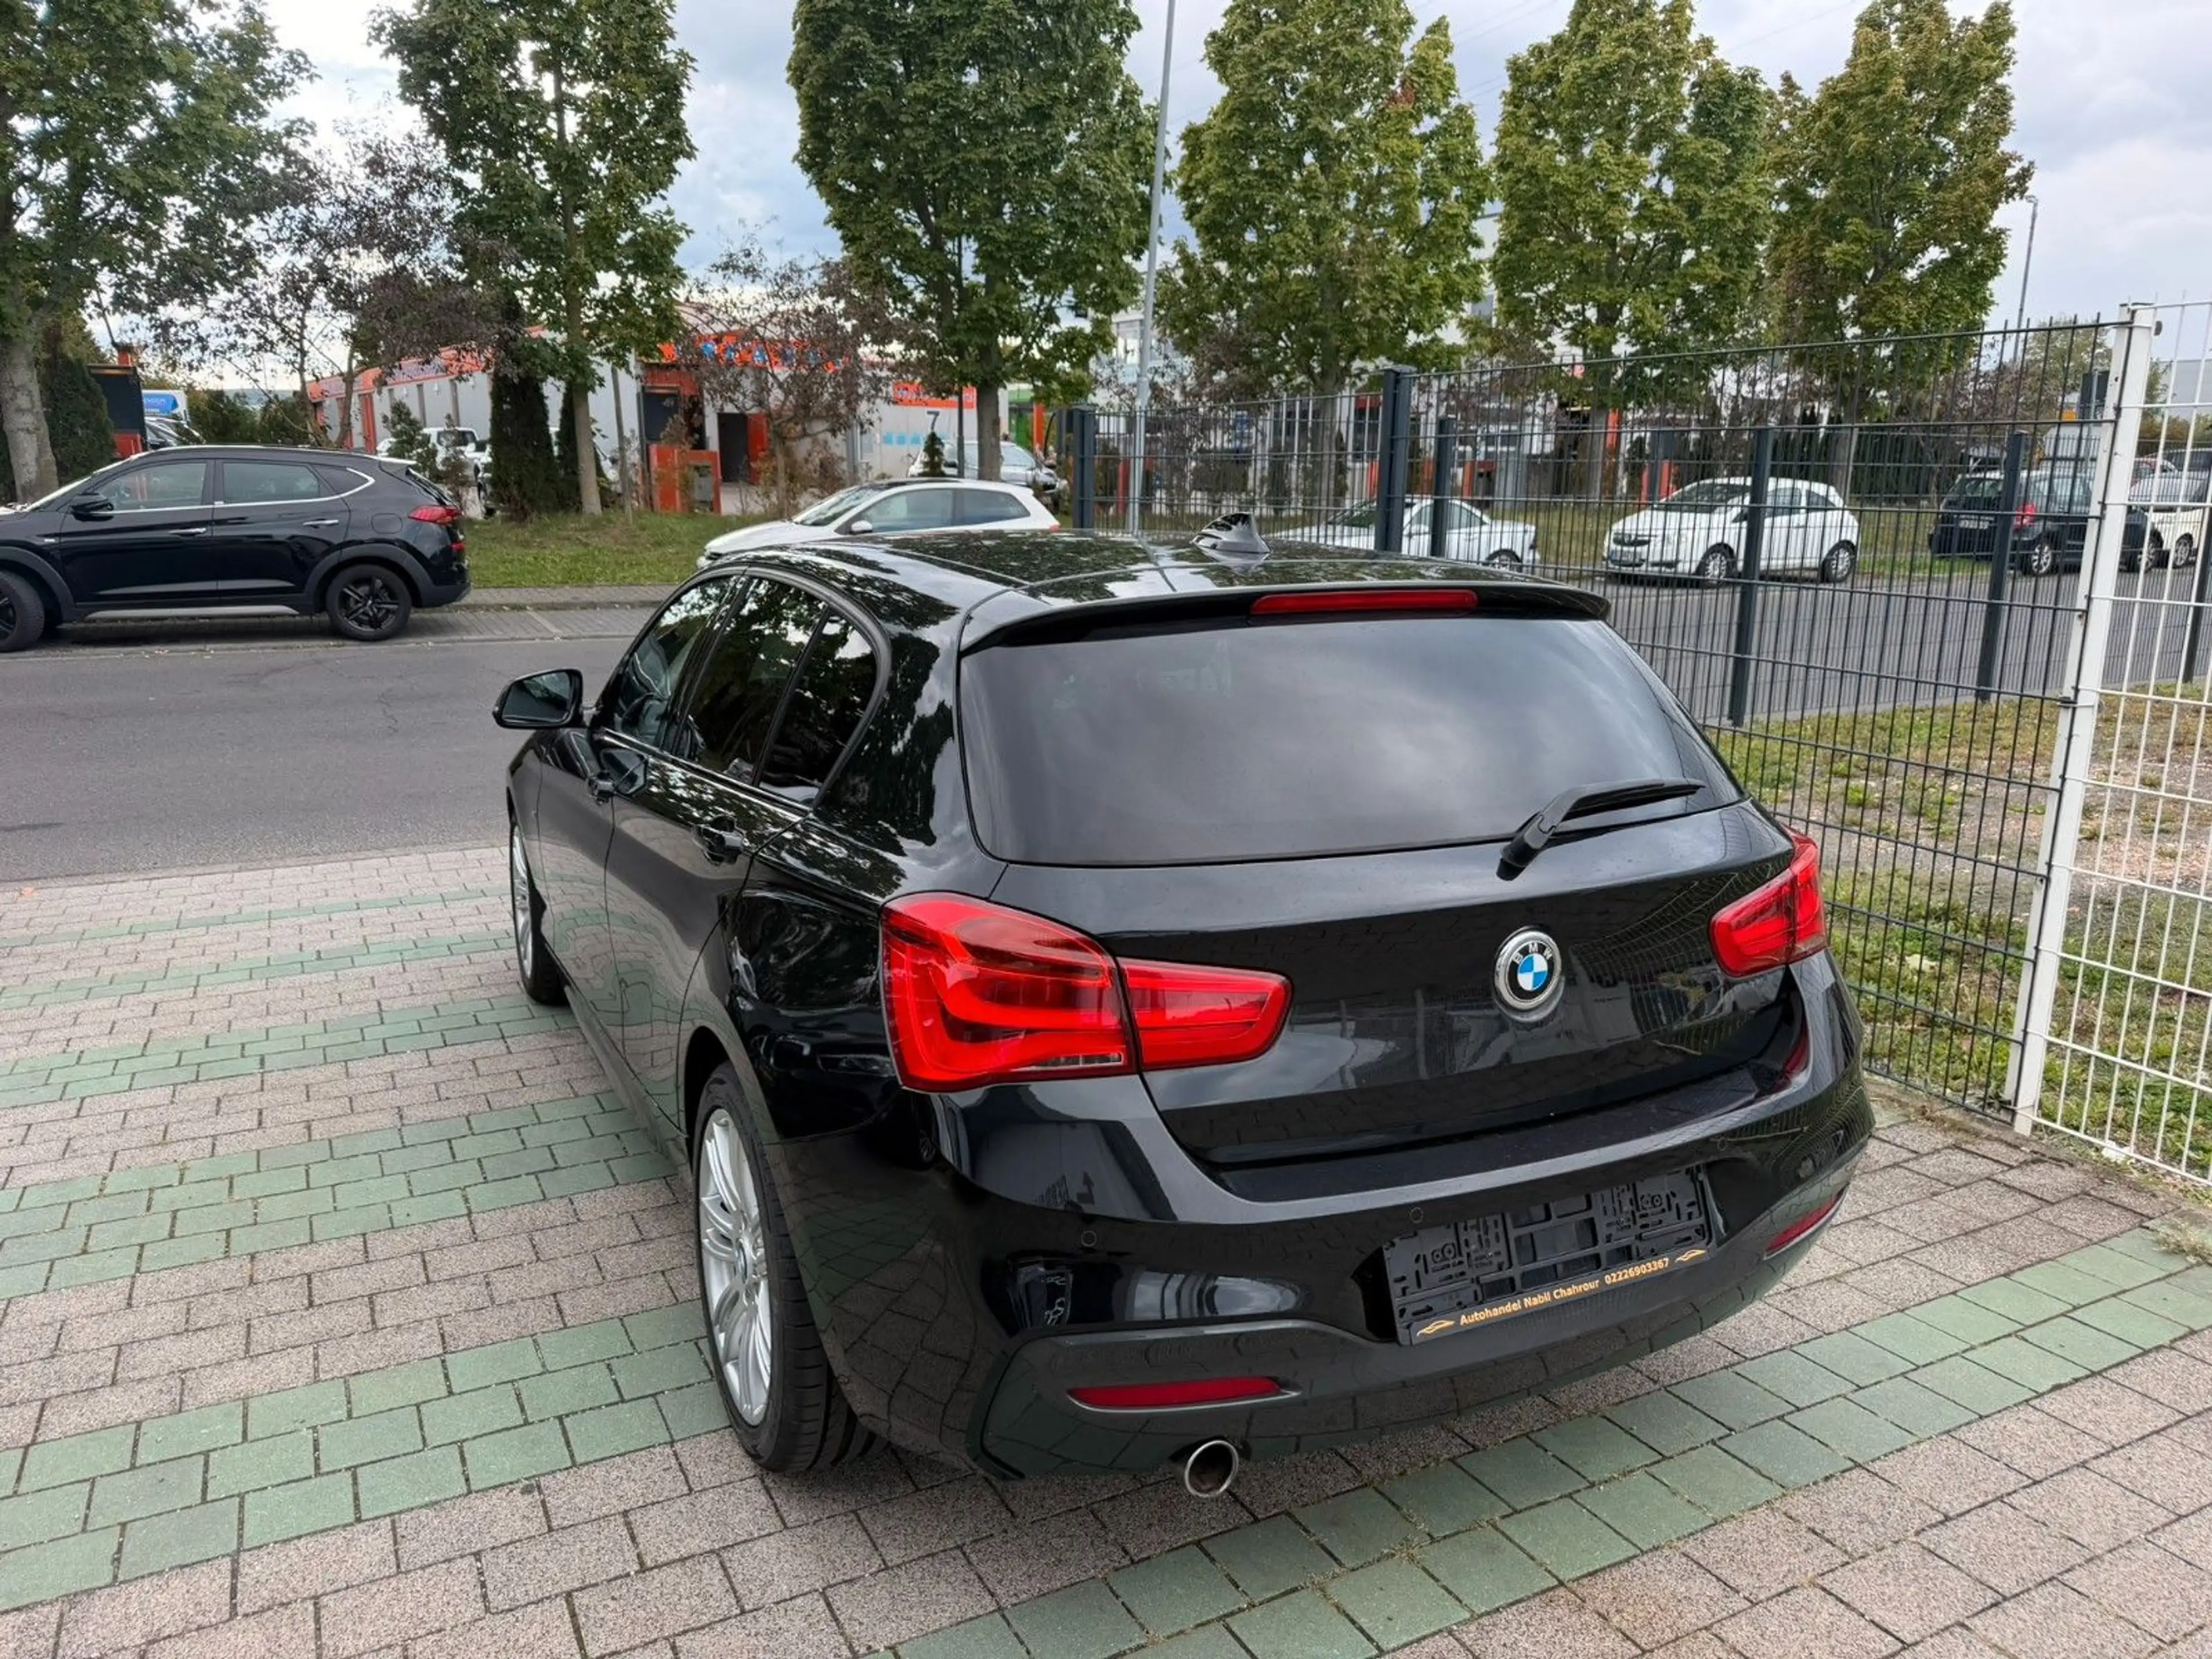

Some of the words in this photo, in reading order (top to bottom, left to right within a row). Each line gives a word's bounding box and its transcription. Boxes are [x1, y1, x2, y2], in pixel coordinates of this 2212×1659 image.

[926, 410, 940, 431] 7
[1512, 942, 1553, 965] BMW
[1460, 1299, 1522, 1325] Autohandel
[1524, 1291, 1551, 1308] Nabil
[1553, 1279, 1600, 1300] Chahrour
[1604, 1257, 1669, 1285] 02226903367
